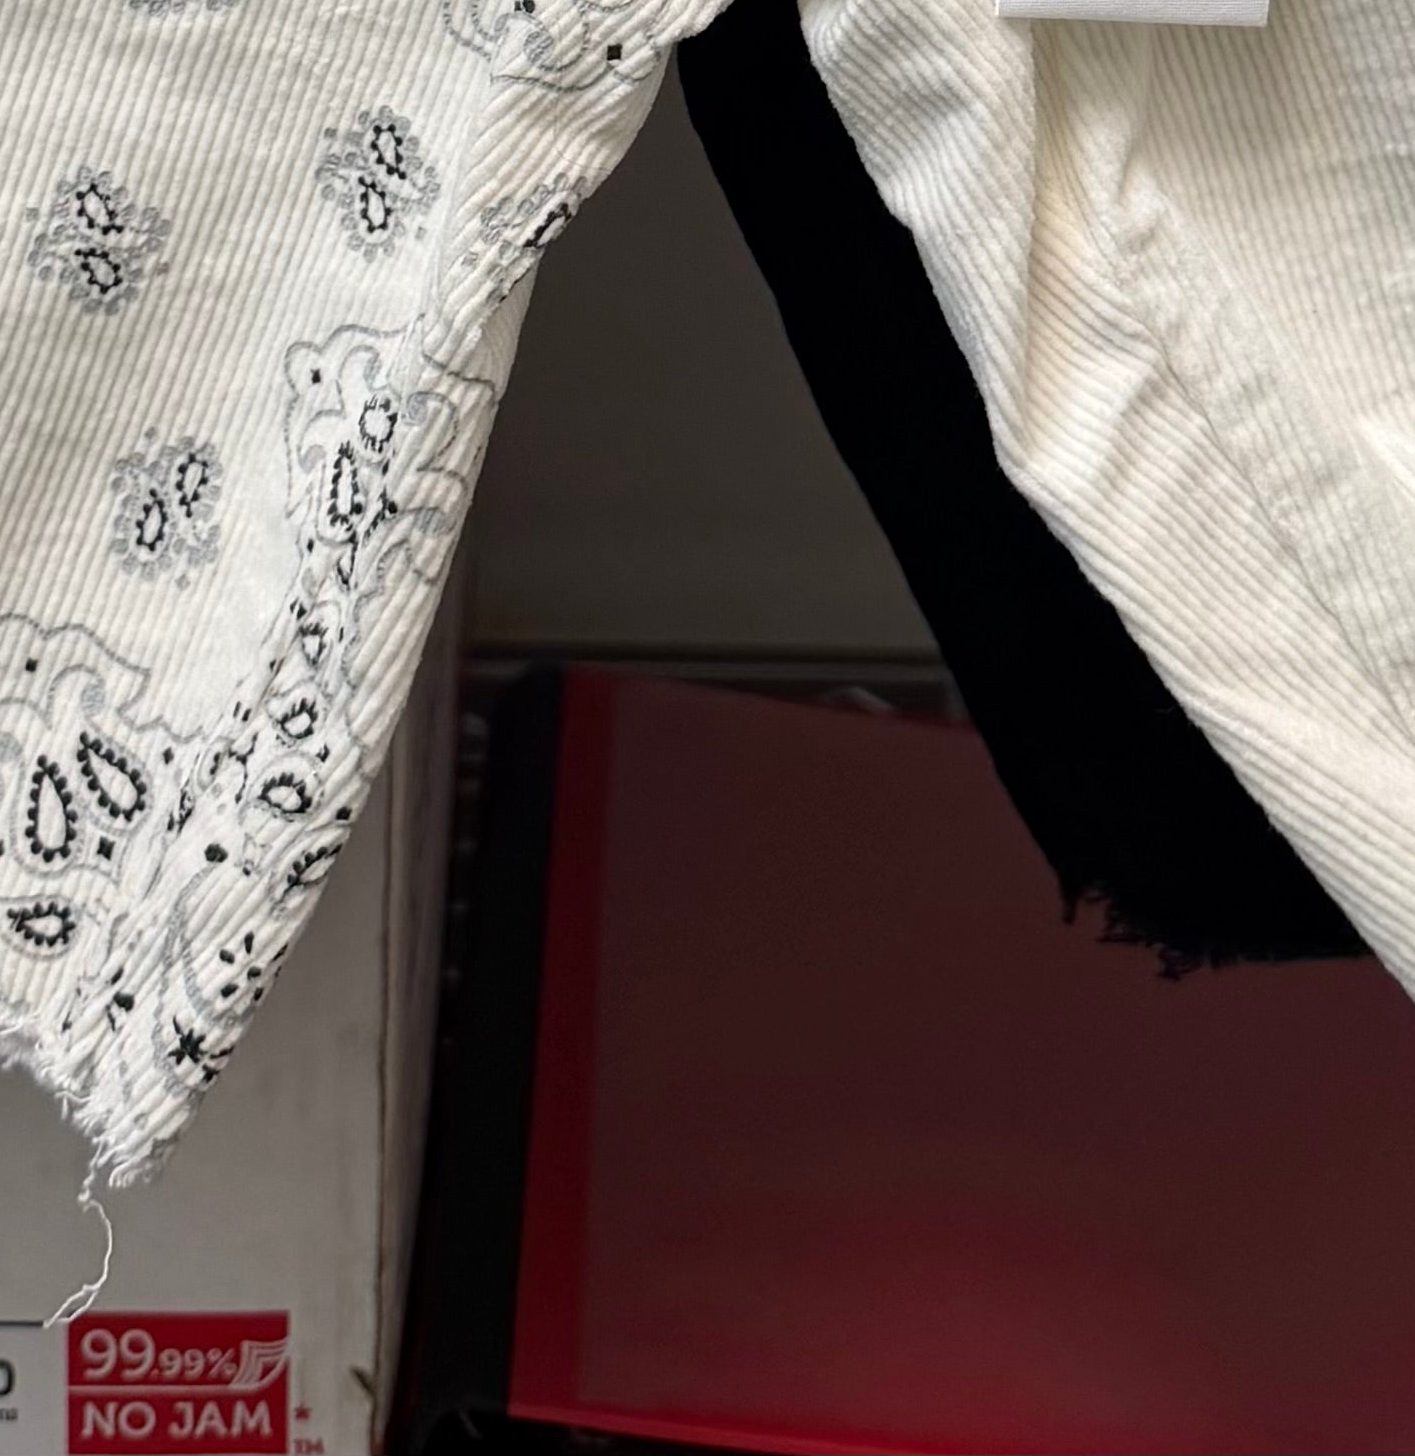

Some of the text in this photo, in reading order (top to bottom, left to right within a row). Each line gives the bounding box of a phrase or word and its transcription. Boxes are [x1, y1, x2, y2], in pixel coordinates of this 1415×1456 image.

[80, 1328, 238, 1380] 99.99%
[81, 1400, 273, 1439] NO JAM
